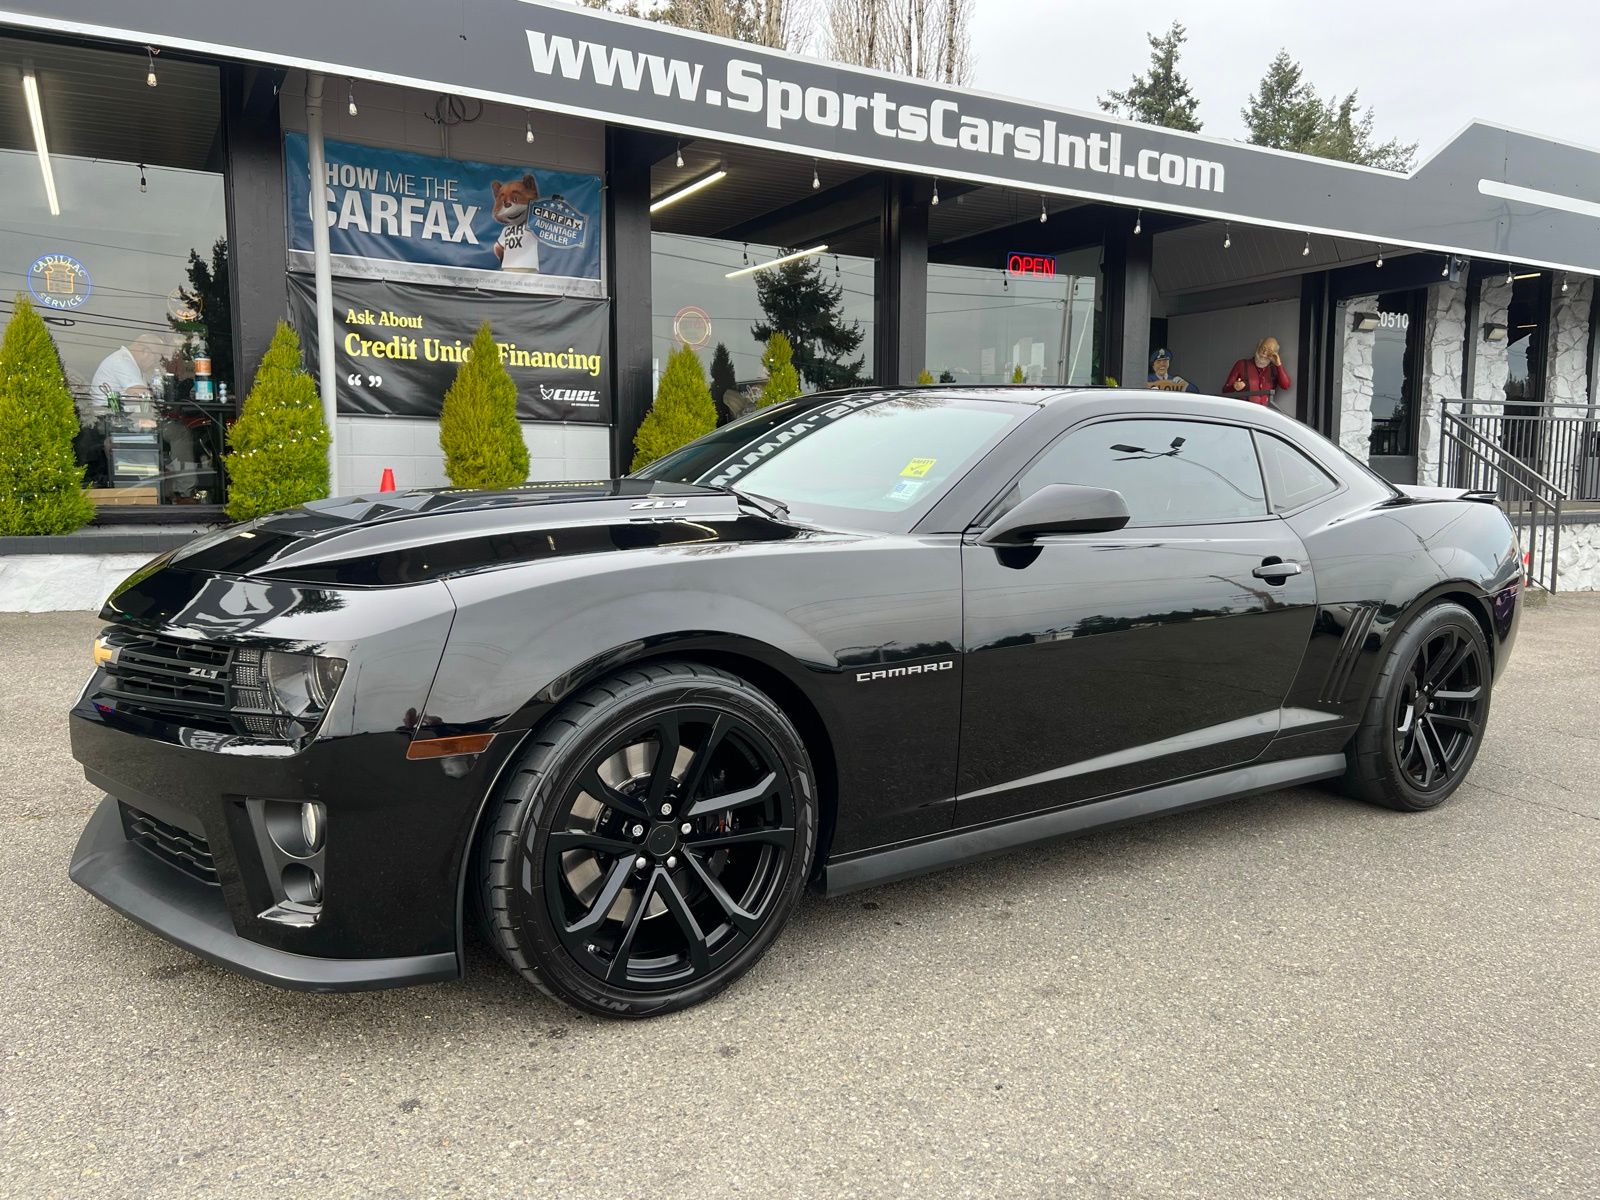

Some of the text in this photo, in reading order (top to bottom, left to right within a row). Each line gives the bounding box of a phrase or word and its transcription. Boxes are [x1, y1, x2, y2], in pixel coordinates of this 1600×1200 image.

[525, 29, 1225, 193] www.SportsCarsIntl.com
[308, 162, 459, 202] HOW ME THE
[534, 207, 583, 231] CARFAX
[535, 219, 578, 240] ADVANTAGE
[504, 236, 523, 250] FOX
[539, 231, 569, 246] DEALER
[33, 255, 86, 277] CADILLAC
[1009, 255, 1055, 280] OPEN
[40, 292, 83, 308] SERVICE
[345, 309, 423, 329] Ask About
[1377, 311, 1409, 329] 0510
[344, 333, 601, 377] Credit Unio Financing
[629, 499, 689, 511] ZL1
[188, 667, 219, 679] ZL1
[856, 660, 954, 682] CAMARO
